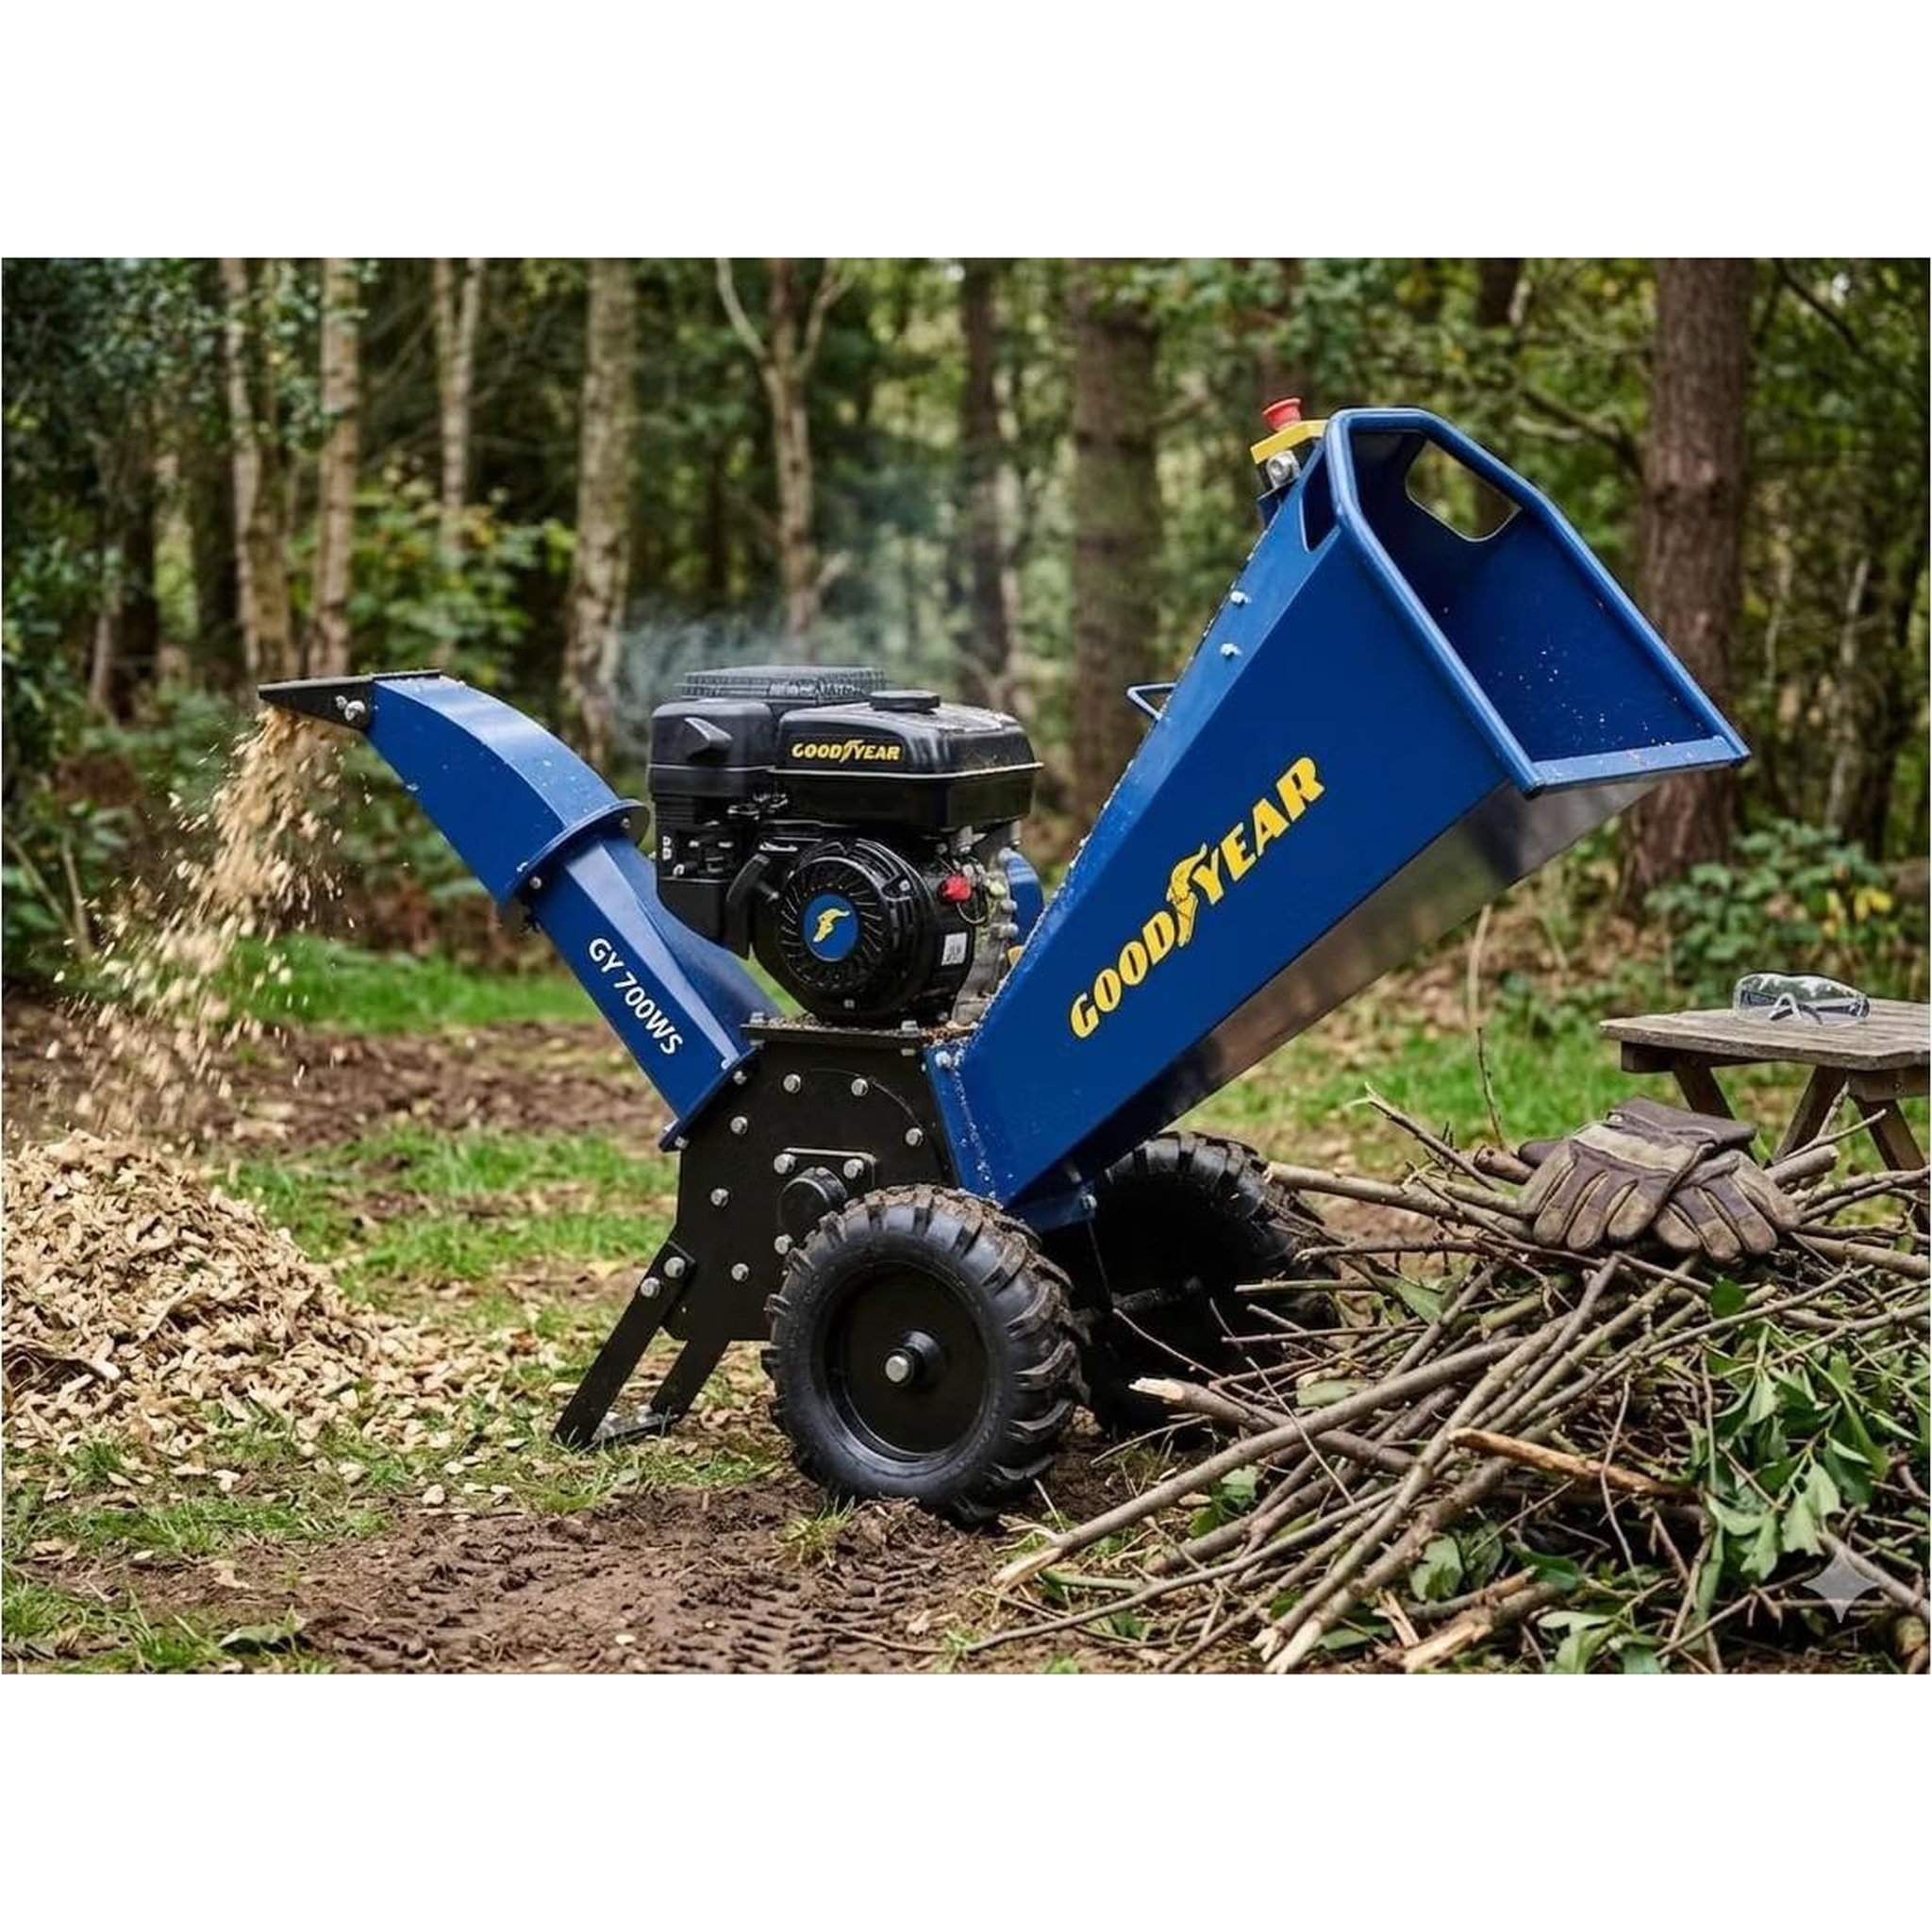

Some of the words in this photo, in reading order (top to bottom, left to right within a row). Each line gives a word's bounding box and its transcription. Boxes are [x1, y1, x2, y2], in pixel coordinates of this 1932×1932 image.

[791, 740, 901, 763] GOODYEAR
[1070, 757, 1324, 1038] GOODYEAR
[589, 938, 625, 973] GY
[614, 971, 683, 1055] 700WS
